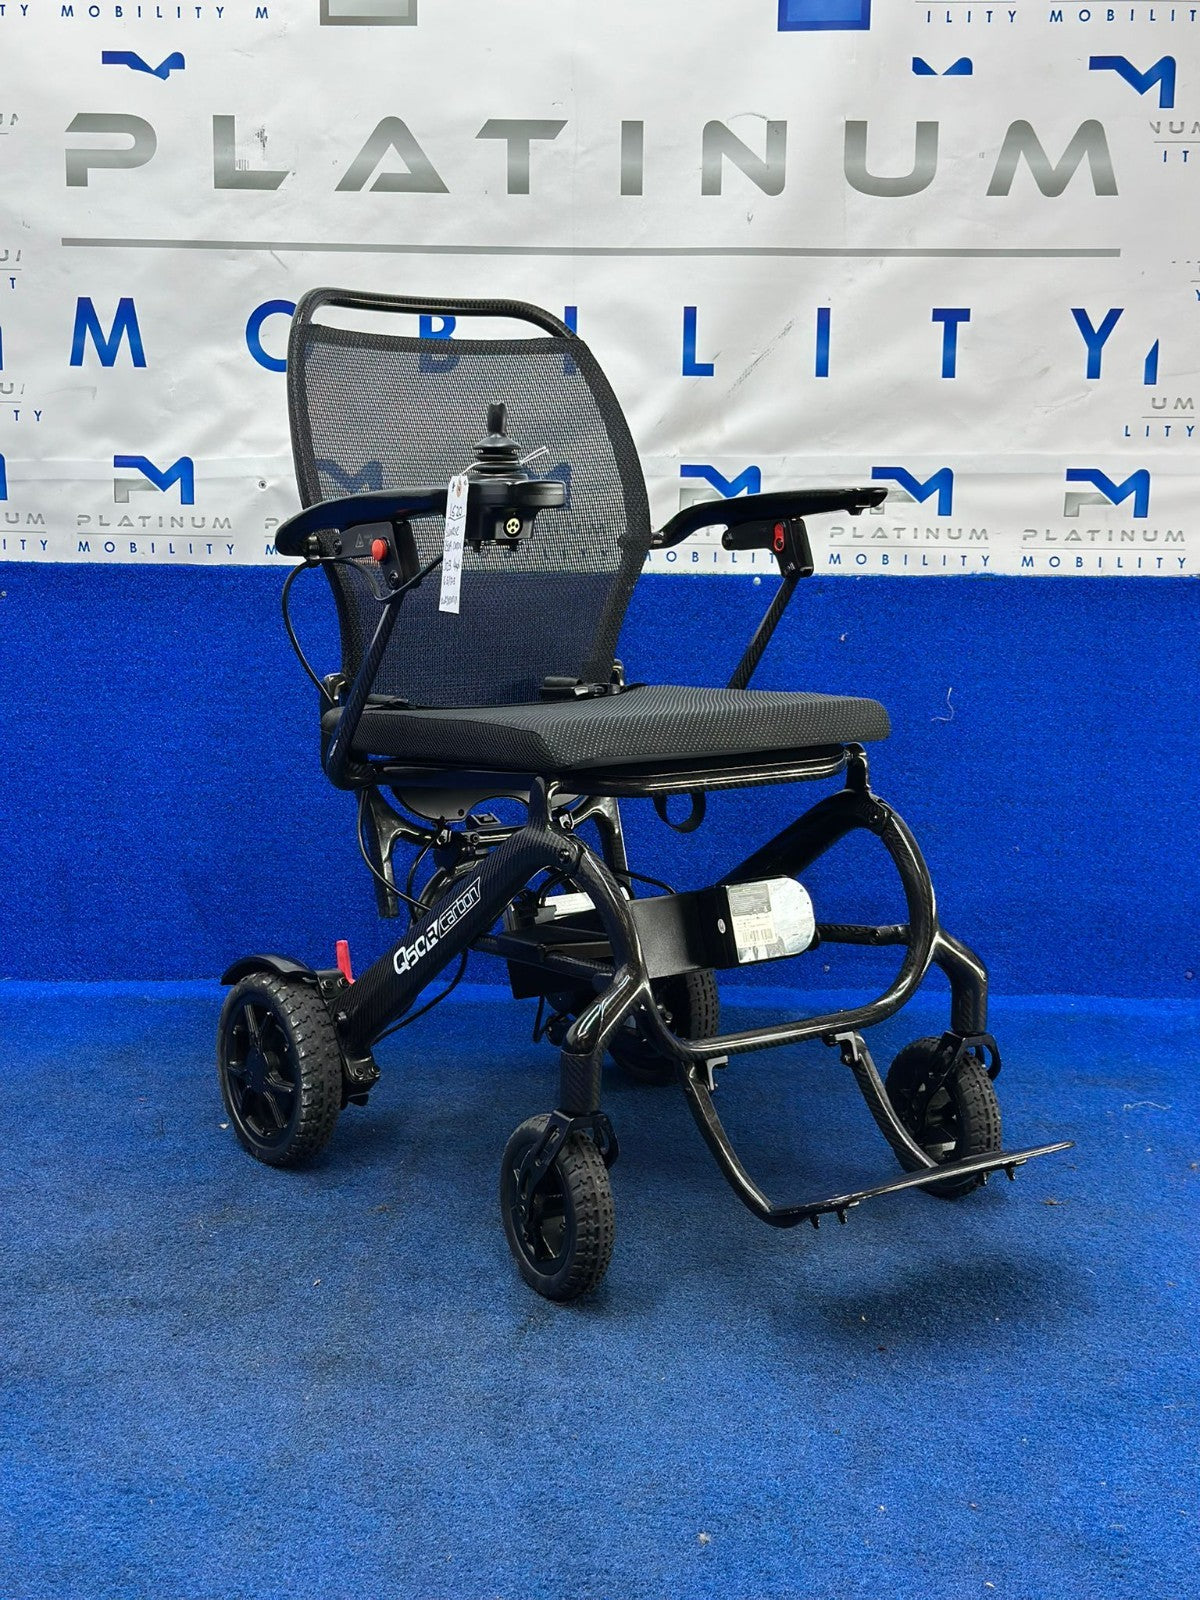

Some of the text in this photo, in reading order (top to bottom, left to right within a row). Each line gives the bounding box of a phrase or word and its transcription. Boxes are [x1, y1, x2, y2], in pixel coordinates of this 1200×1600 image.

[60, 4, 225, 19] MOBILITY
[64, 111, 1120, 198] PLATINUM
[69, 296, 1125, 381] MOBILITY
[76, 514, 232, 530] PLATINUM
[829, 527, 989, 541] PLATINUM
[1022, 528, 1186, 543] PLATINUM
[77, 541, 235, 555] MOBILITY
[828, 553, 990, 568] MOBILITY
[1021, 555, 1187, 569] MOBILITY
